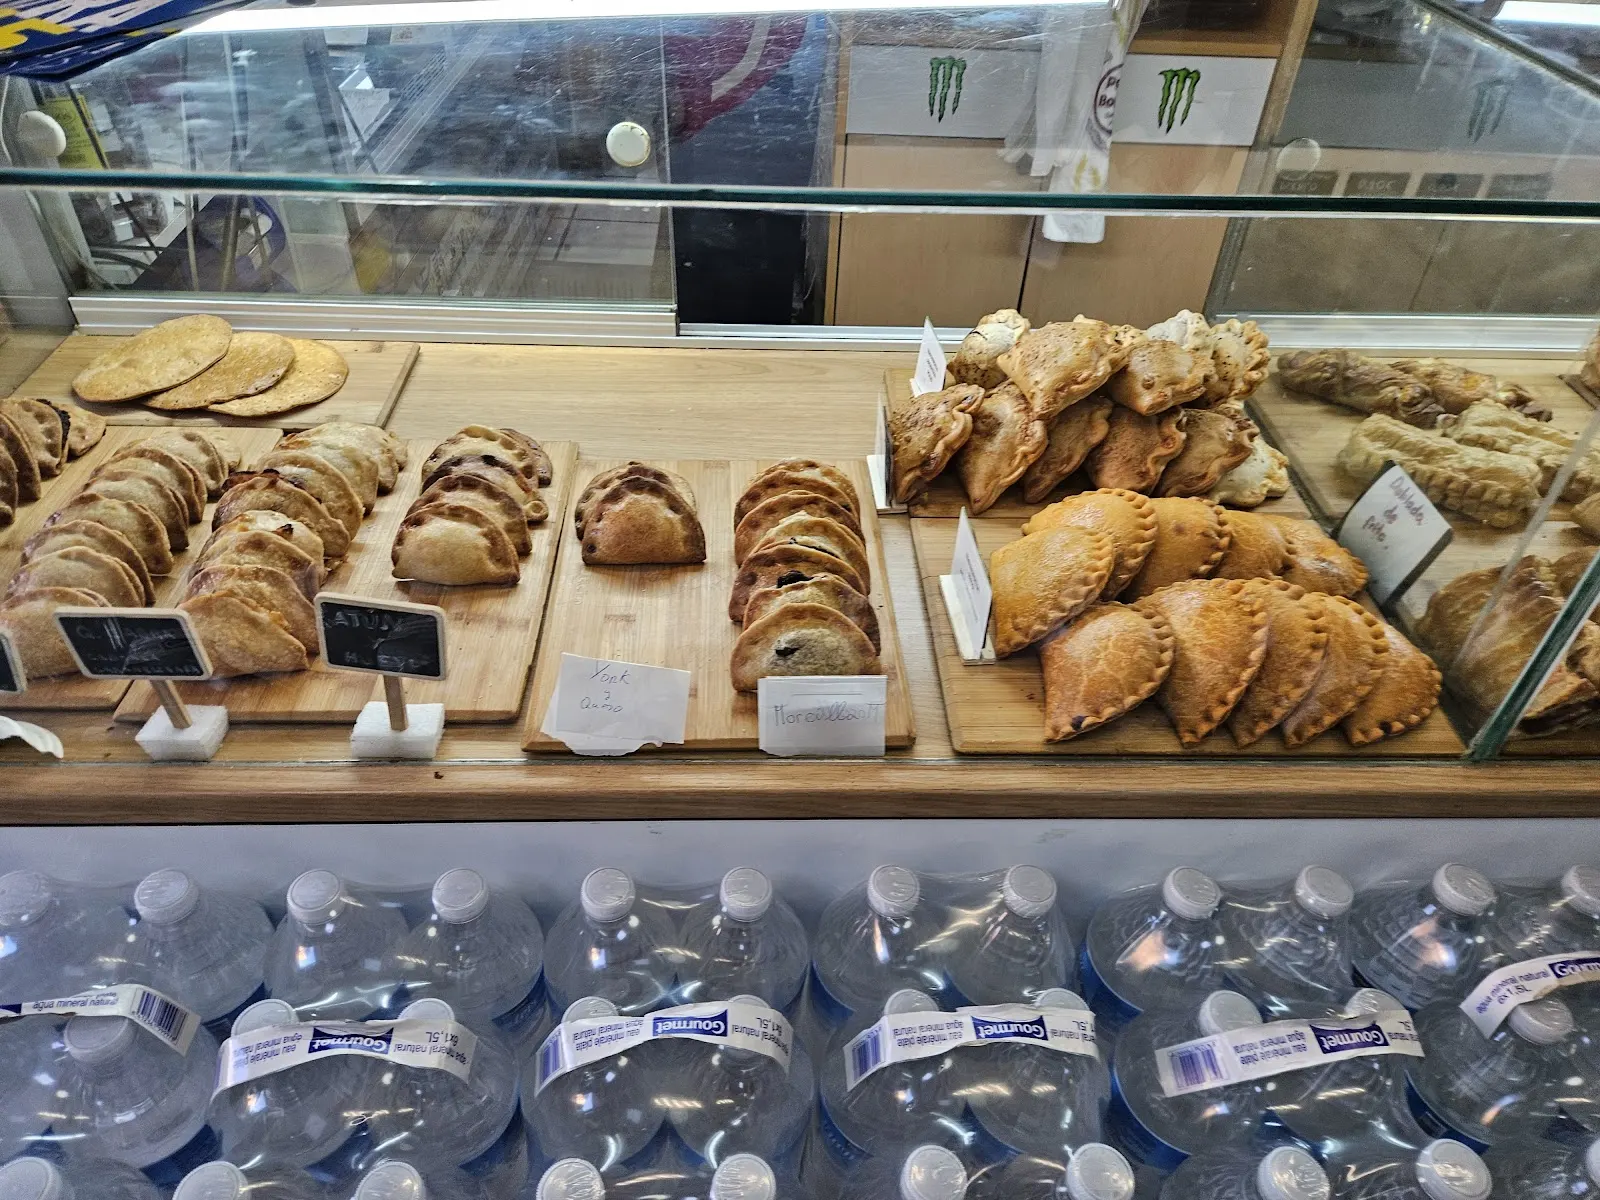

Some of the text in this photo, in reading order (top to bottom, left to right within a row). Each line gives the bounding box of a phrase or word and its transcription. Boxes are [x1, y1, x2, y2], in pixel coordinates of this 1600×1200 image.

[589, 660, 631, 685] York
[655, 1020, 726, 1035] Gourmet
[977, 1023, 1045, 1039] Gourmet
[312, 1037, 388, 1053] Gourmet
[1319, 1030, 1385, 1051] Gourmet
